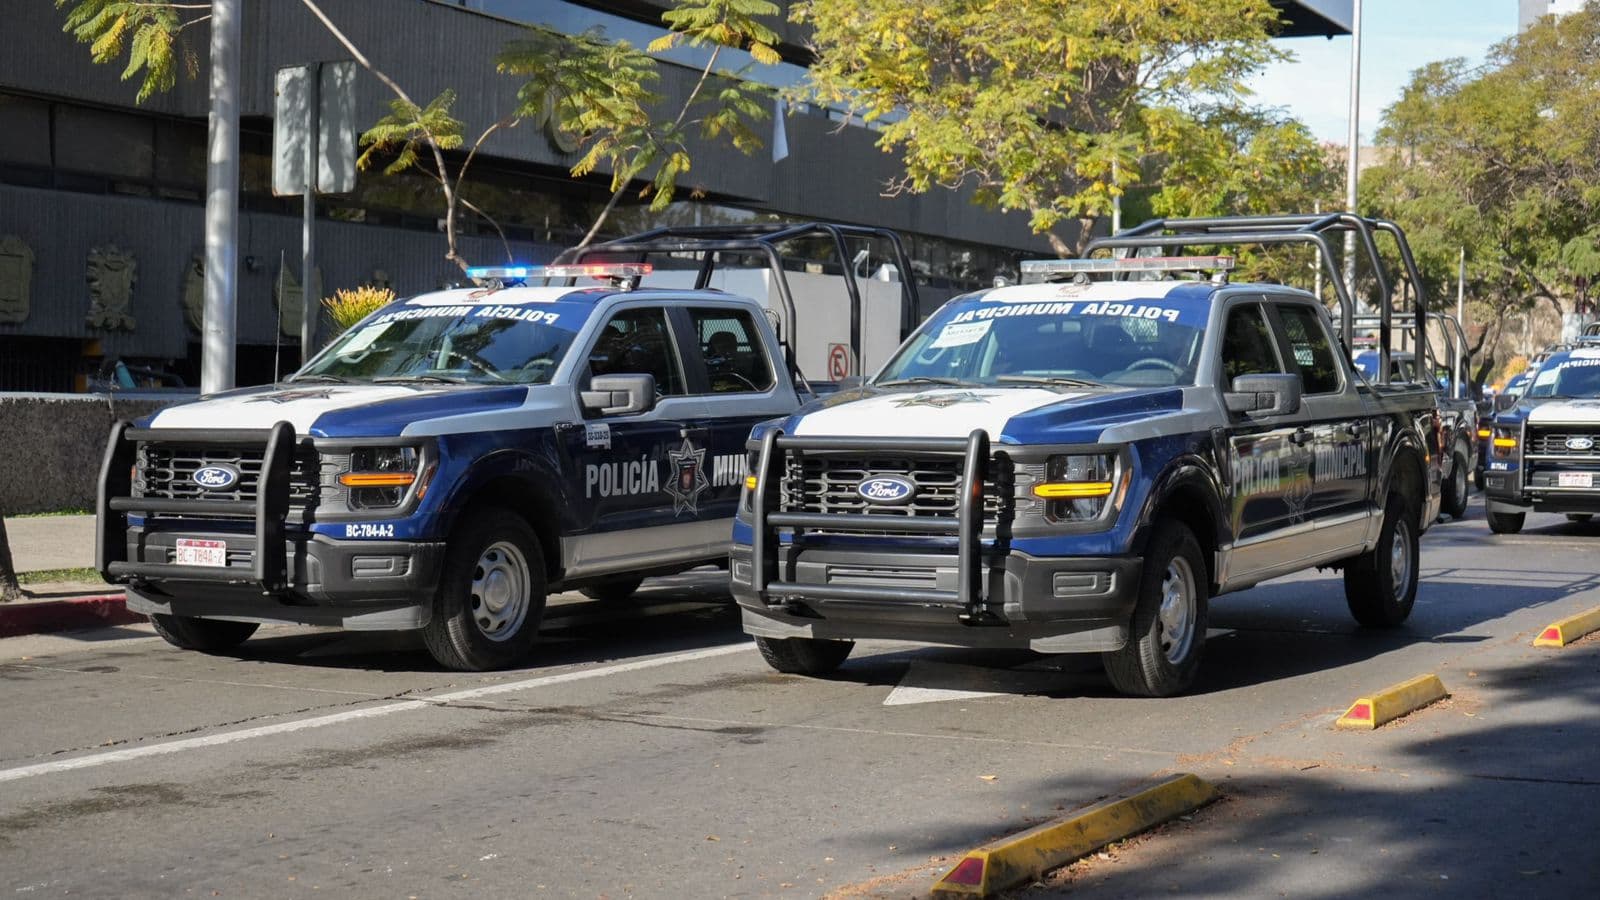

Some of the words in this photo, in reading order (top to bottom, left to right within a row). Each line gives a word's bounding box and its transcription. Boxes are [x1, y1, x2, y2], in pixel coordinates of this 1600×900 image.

[1315, 444, 1367, 484] MUNICIPAL
[198, 470, 226, 485] Ford
[585, 454, 660, 498] POLICÍA
[867, 481, 901, 498] Ford
[346, 524, 394, 537] BC-784-A-2
